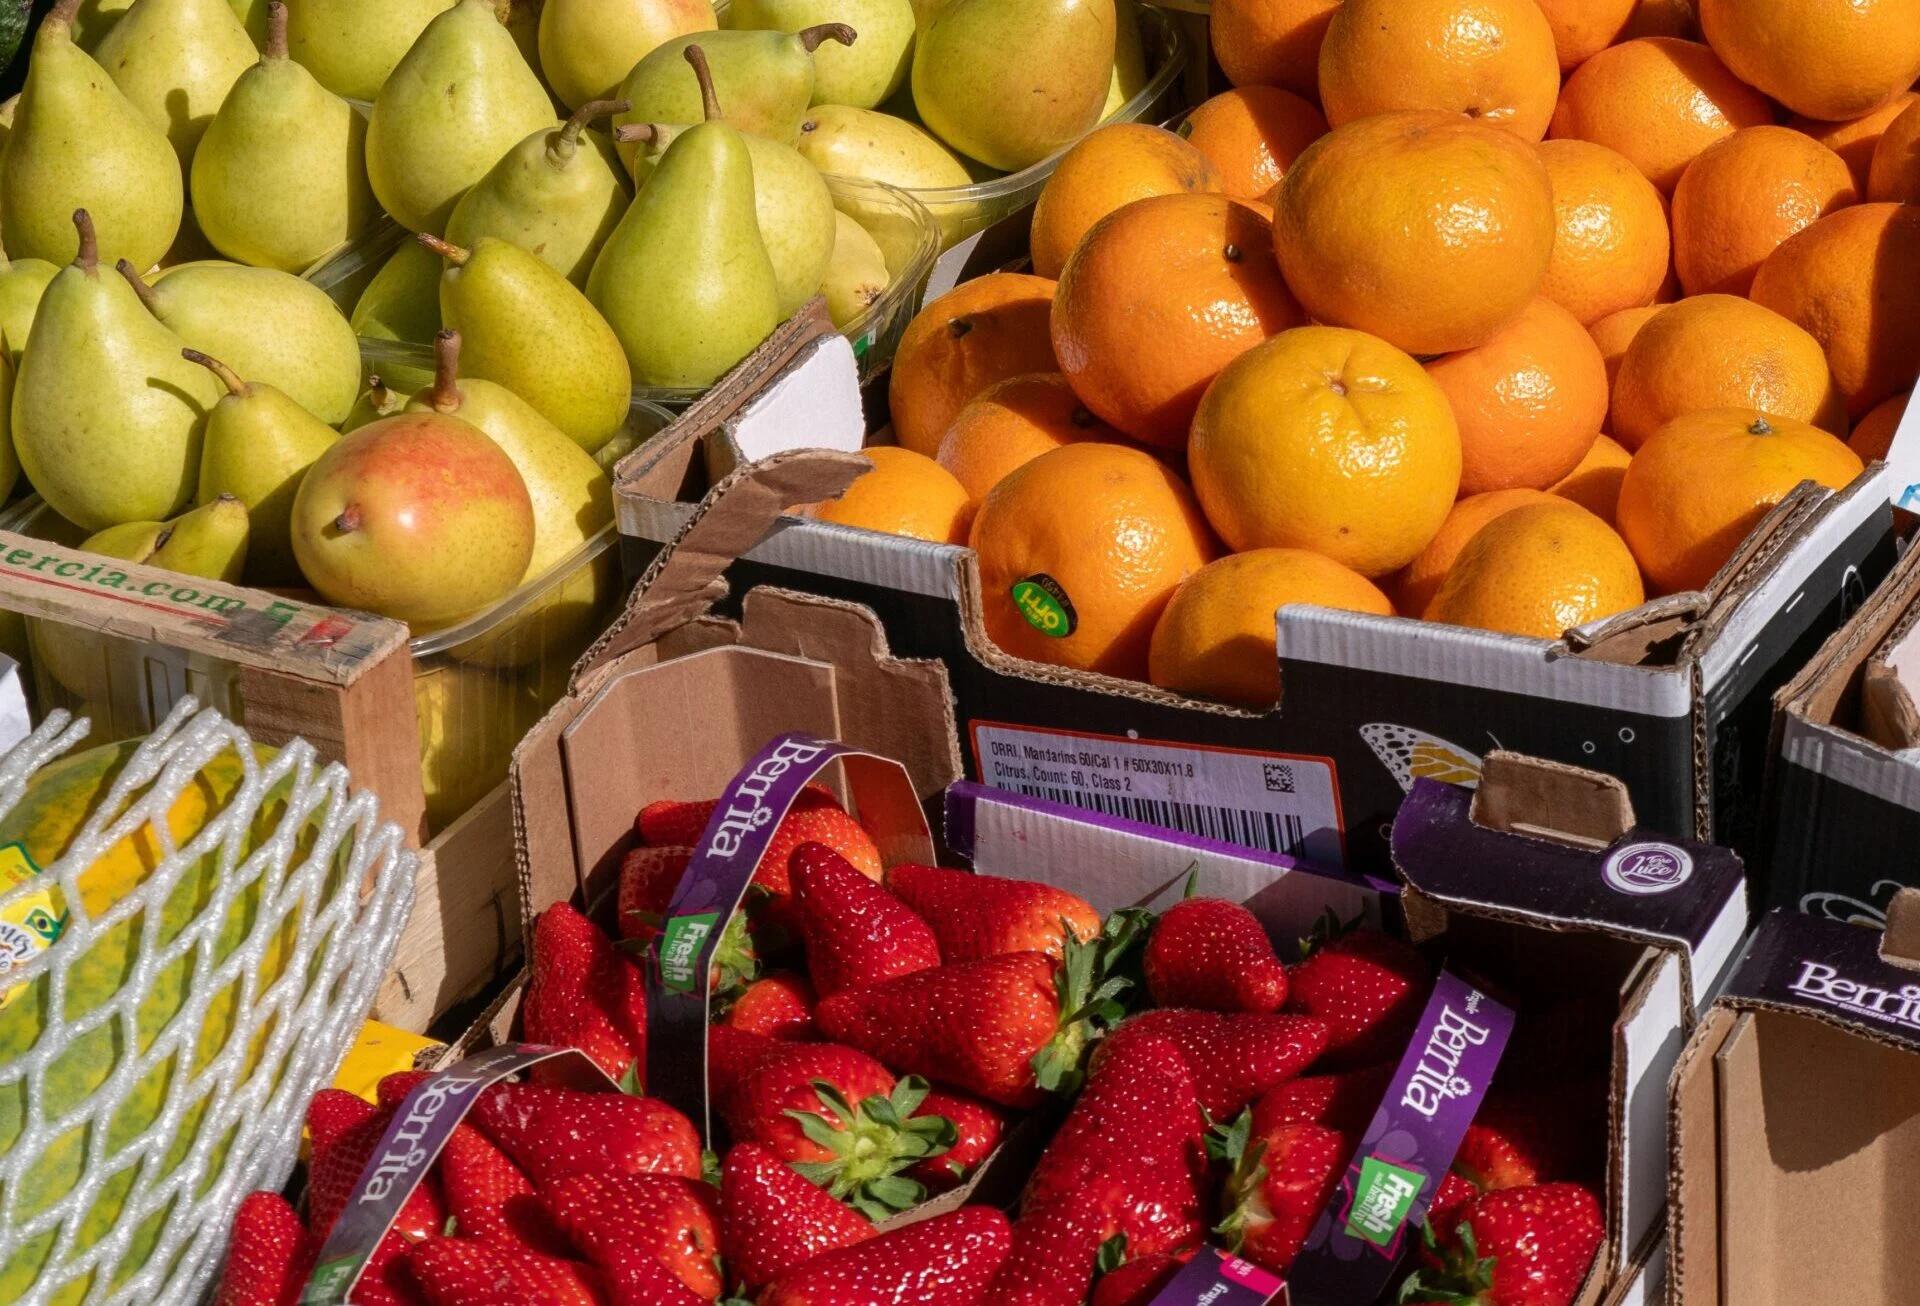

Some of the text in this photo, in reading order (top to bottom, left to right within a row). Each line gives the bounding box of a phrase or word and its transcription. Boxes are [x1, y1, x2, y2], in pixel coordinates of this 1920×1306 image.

[0, 543, 247, 614] ercia.com
[1023, 745, 1077, 765] Mandarins
[1079, 752, 1110, 769] 60/Cal
[1033, 766, 1068, 785] Count:
[1091, 773, 1121, 791] Class
[1124, 777, 1132, 791] 2
[705, 738, 827, 859] Berrita
[672, 922, 710, 982] Fresh
[1401, 1004, 1491, 1117] Berrita
[358, 1074, 486, 1206] Berrita
[1363, 1173, 1415, 1234] Fresh
